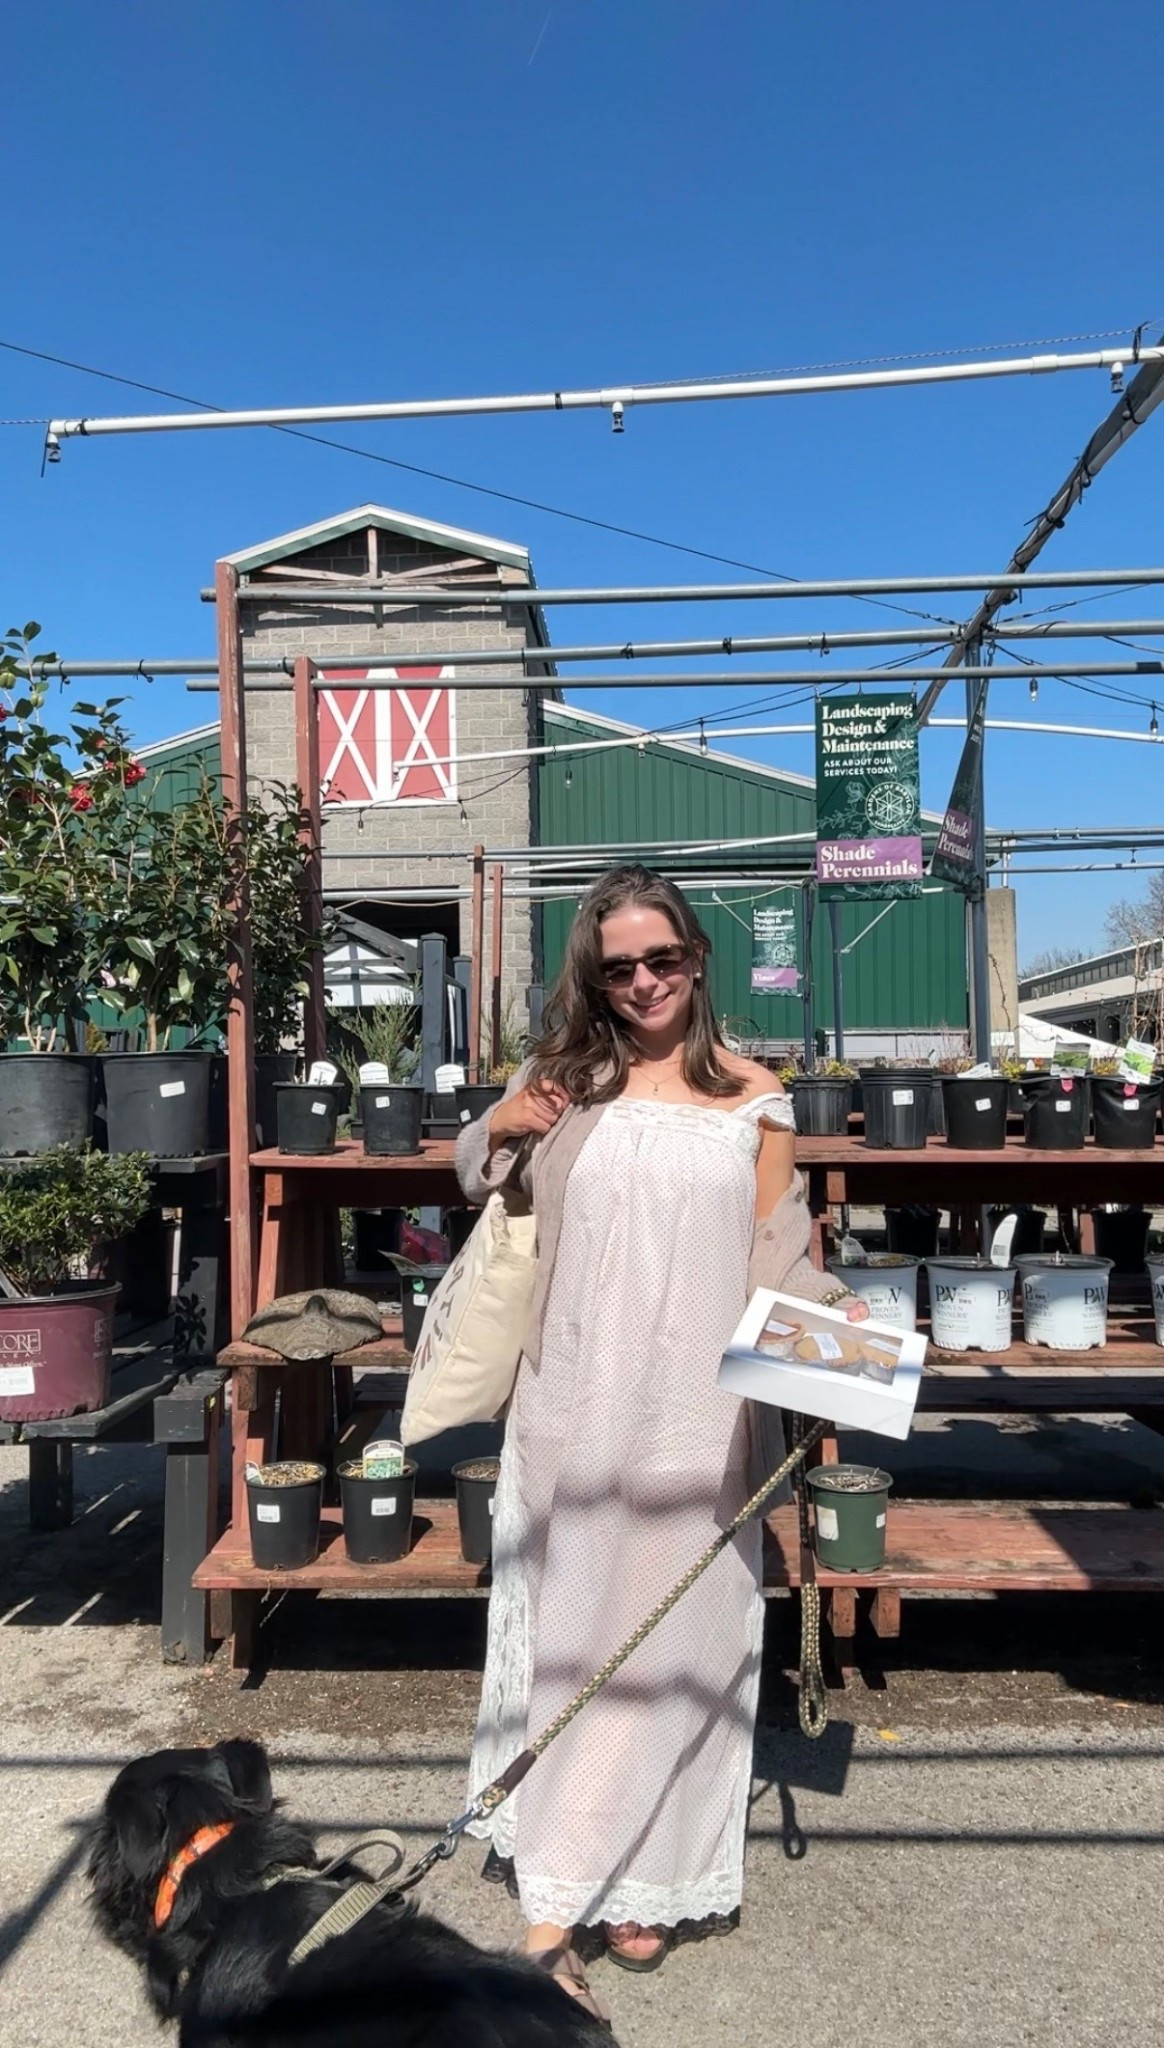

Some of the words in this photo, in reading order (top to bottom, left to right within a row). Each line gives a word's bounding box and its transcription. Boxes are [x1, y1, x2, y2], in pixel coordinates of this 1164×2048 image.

[822, 703, 914, 722] Landscaping
[822, 720, 872, 738] Design
[873, 719, 887, 734] &
[822, 739, 915, 754] Maintenance
[824, 760, 841, 768] ASK
[842, 757, 872, 767] ABOUT
[873, 756, 893, 765] OUR
[824, 767, 865, 777] SERVICES
[866, 765, 898, 775] TODAY!
[943, 815, 969, 840] Shade
[820, 844, 876, 862] Shade
[821, 859, 919, 879] Perennials
[0, 1334, 38, 1355] ORE
